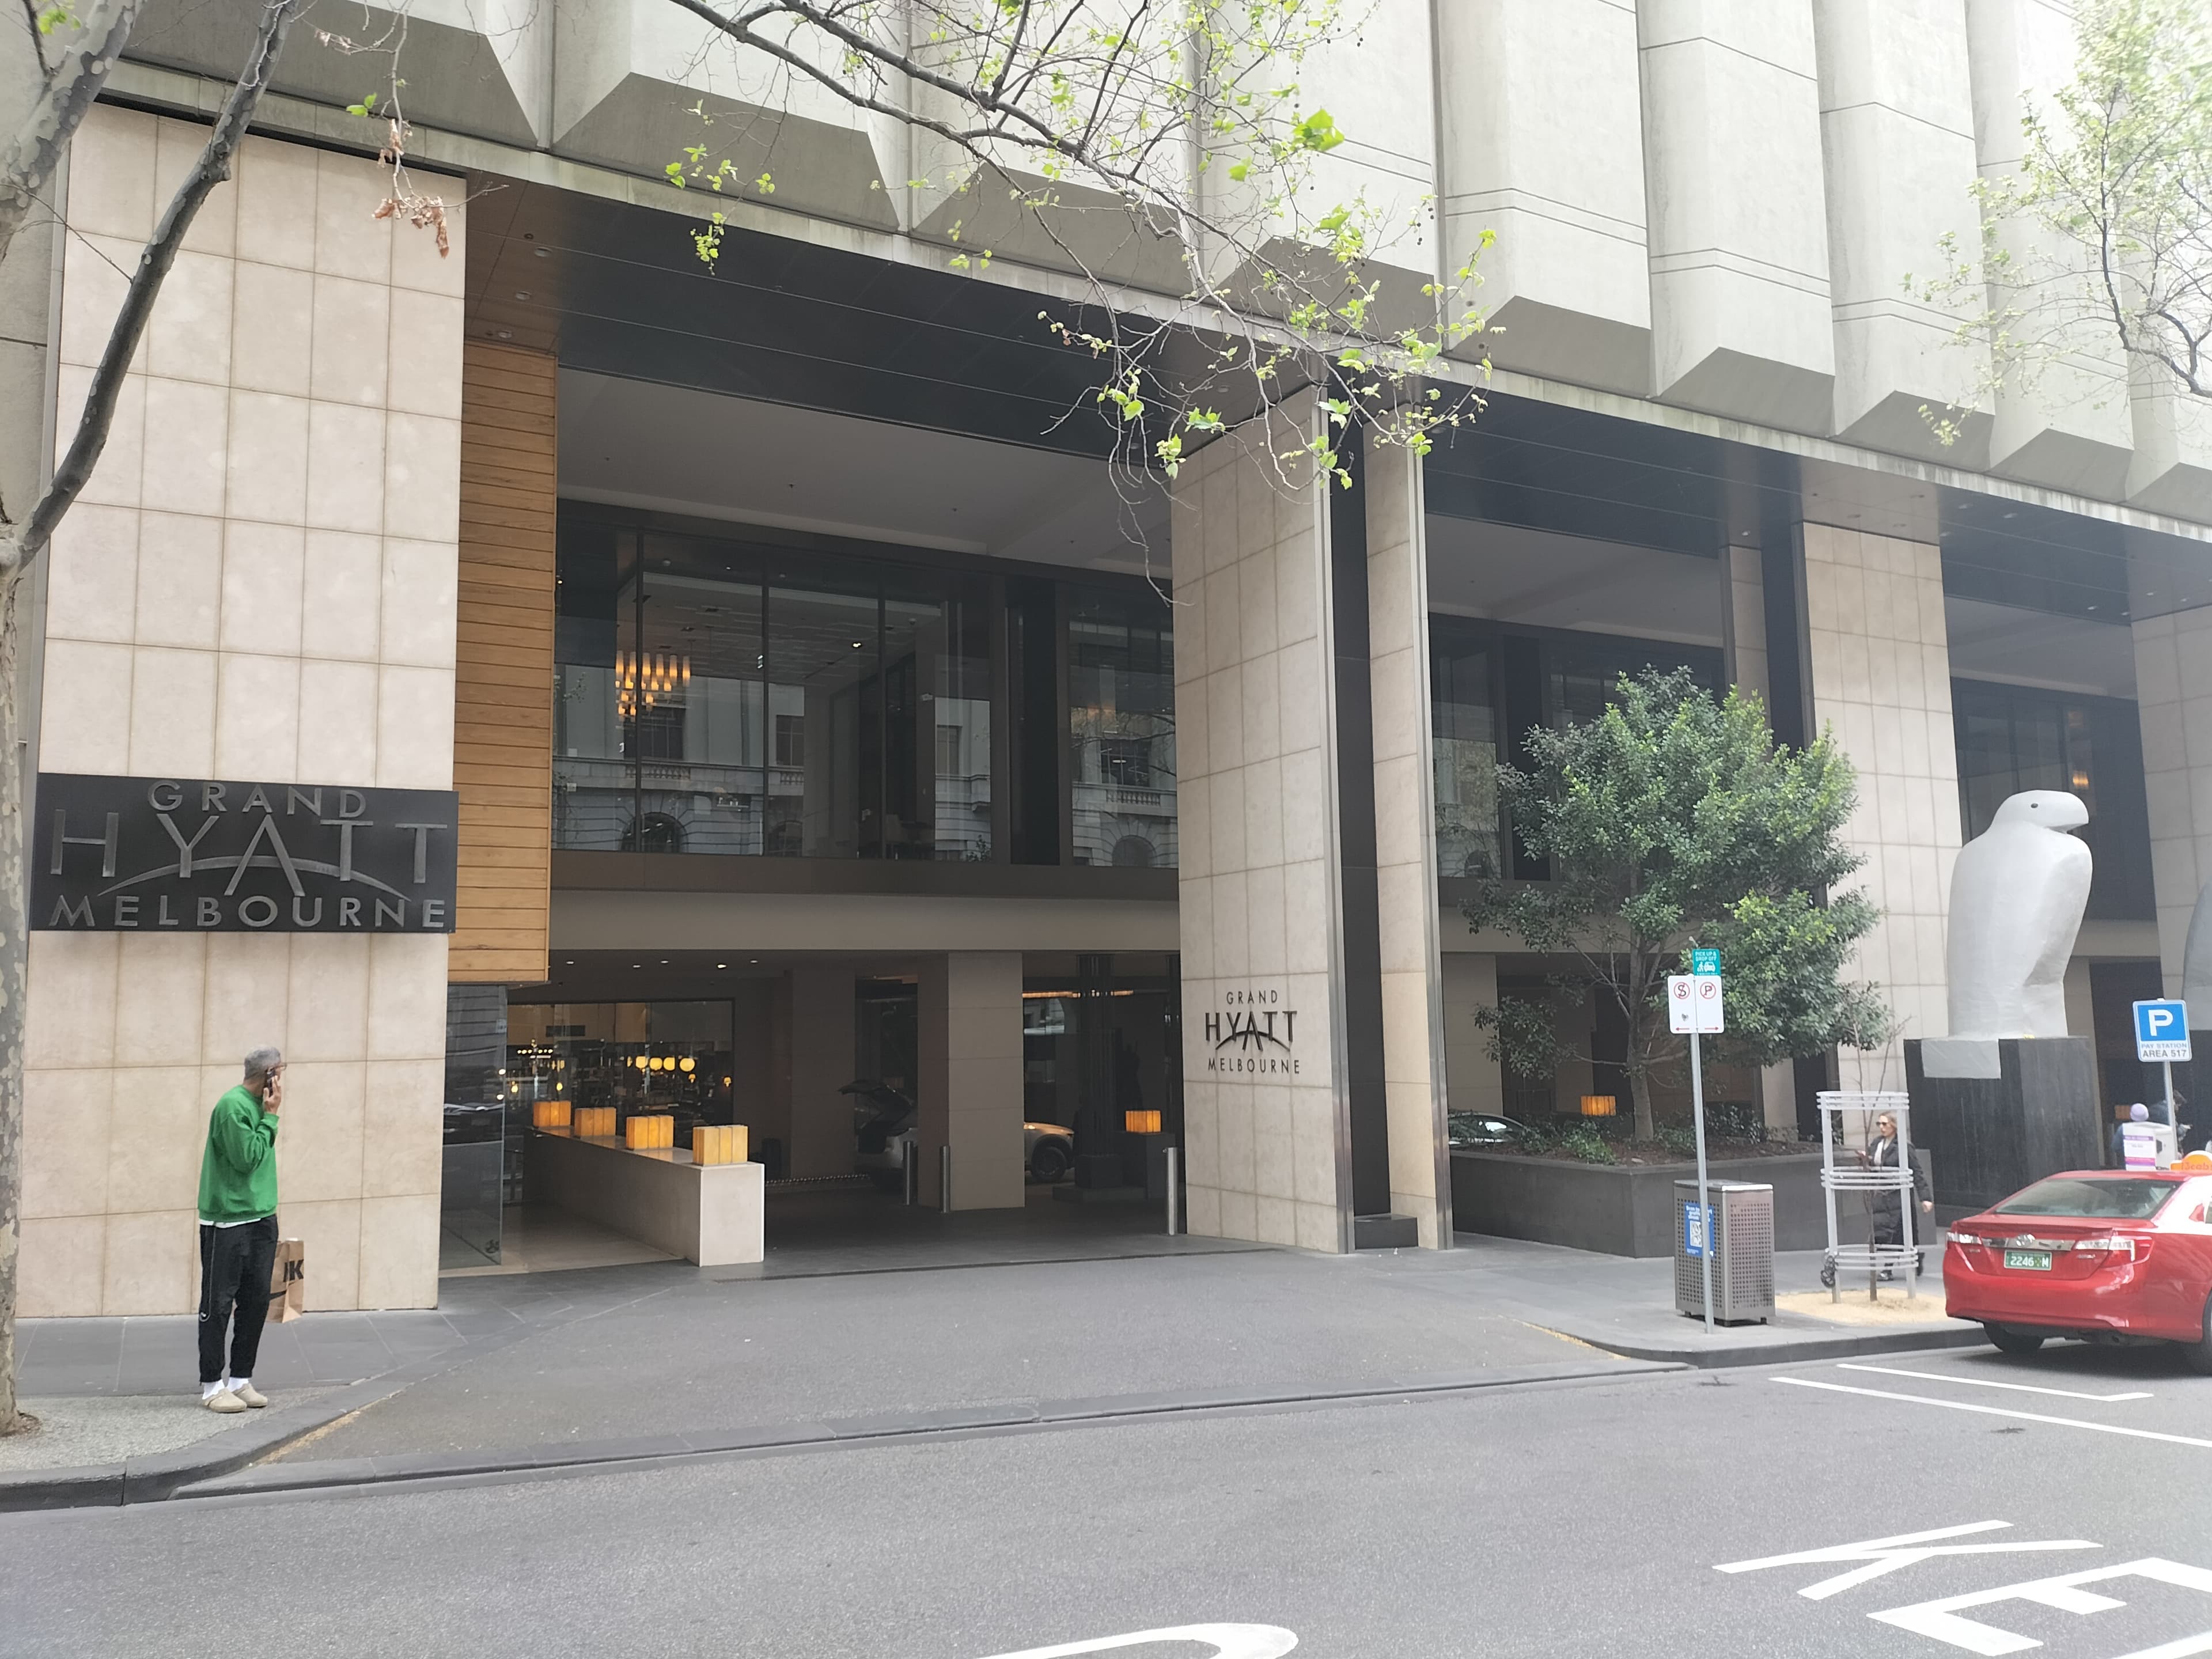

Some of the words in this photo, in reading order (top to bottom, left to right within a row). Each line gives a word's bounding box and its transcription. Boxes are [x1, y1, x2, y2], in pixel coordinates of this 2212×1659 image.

[147, 780, 367, 819] GRAND
[50, 809, 448, 896] HYATT
[49, 895, 446, 928] MELBOURNE
[1226, 990, 1278, 1005] GRAND
[1205, 1011, 1297, 1051] HYATT
[2148, 1009, 2173, 1036] P
[1208, 1058, 1300, 1074] MELBOURNE
[2143, 1050, 2168, 1058] AREA
[2010, 1256, 2035, 1267] 2246
[2041, 1257, 2050, 1267] M
